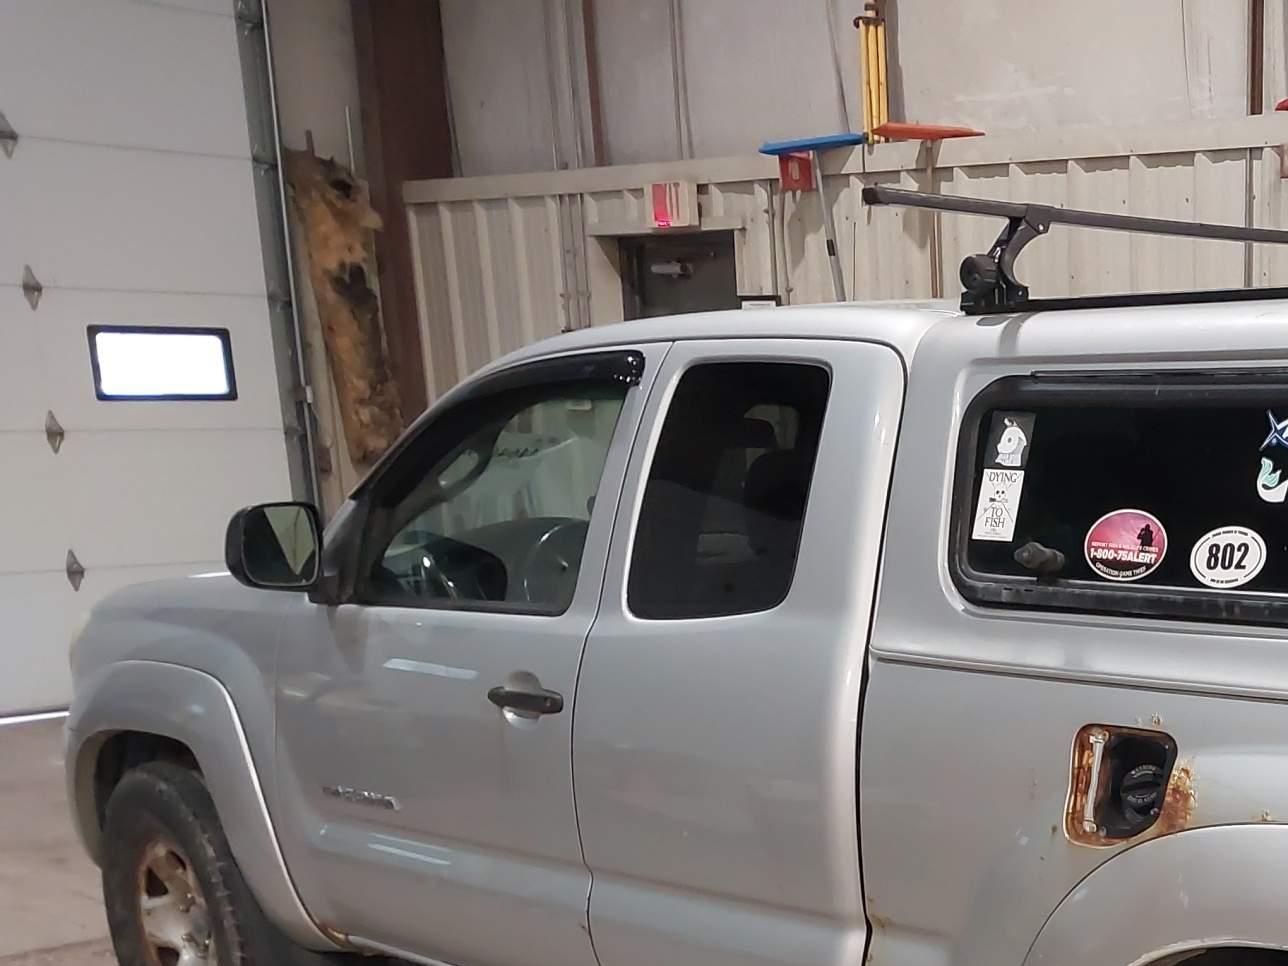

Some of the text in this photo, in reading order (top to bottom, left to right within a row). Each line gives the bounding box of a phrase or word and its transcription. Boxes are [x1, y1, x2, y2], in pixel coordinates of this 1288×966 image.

[989, 471, 1018, 483] DYING
[992, 507, 1004, 517] TO
[984, 517, 1005, 528] FISH
[1090, 547, 1158, 564] 1-800-75ALERT
[1206, 543, 1250, 570] 802
